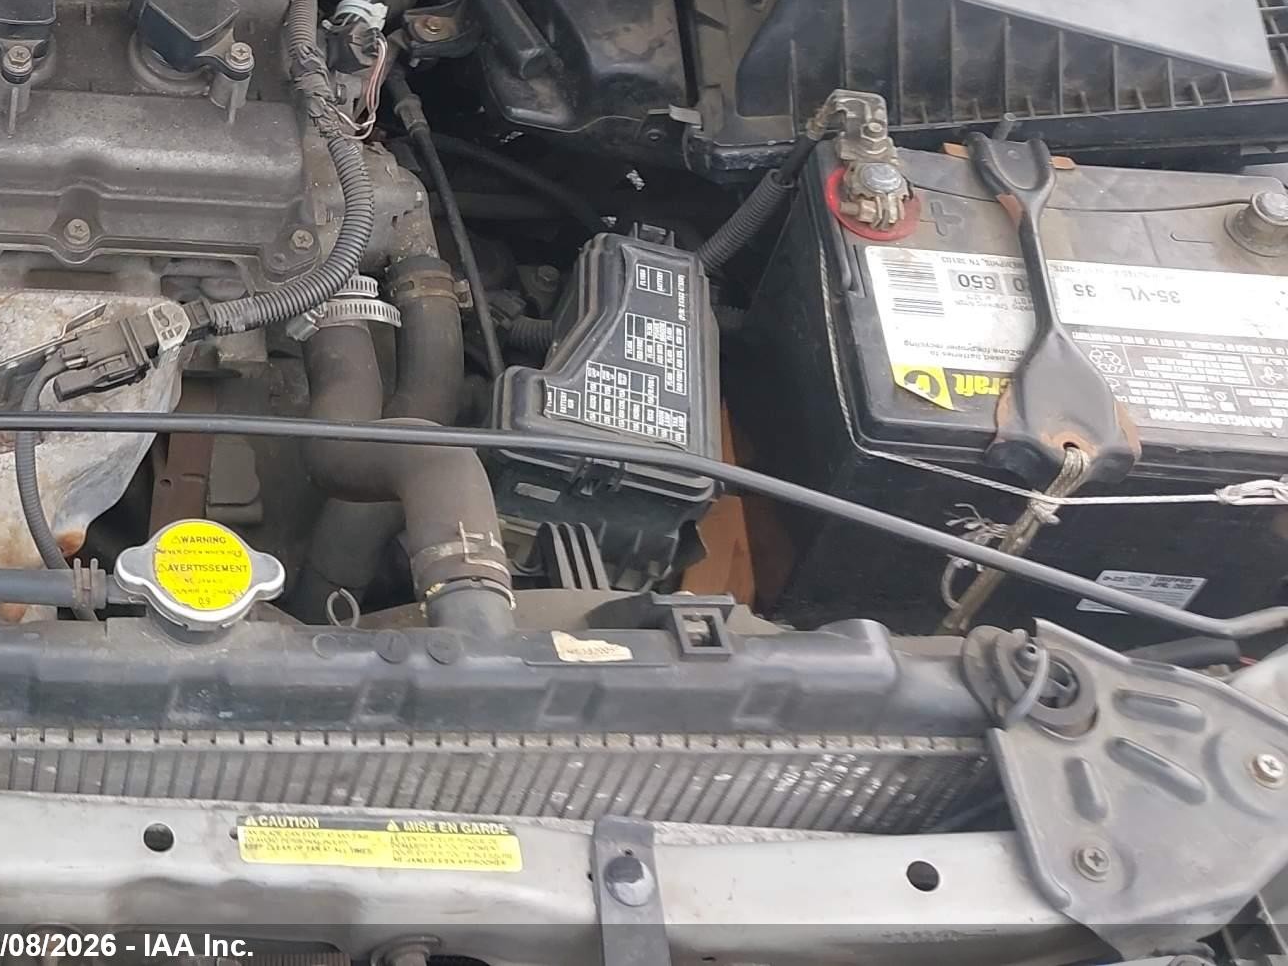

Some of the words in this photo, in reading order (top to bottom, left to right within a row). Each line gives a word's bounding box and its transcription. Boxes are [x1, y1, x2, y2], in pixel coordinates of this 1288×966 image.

[957, 273, 997, 291] 650
[1073, 283, 1097, 298] 35
[1121, 286, 1181, 305] 35-VL
[1148, 408, 1273, 429] DANGER/POISON
[181, 536, 227, 544] WARNING
[167, 564, 248, 572] AVERTISSEMENT
[259, 816, 320, 829] CAUTION
[402, 821, 437, 833] MISE
[438, 821, 459, 833] EN
[460, 822, 509, 835] GARDE
